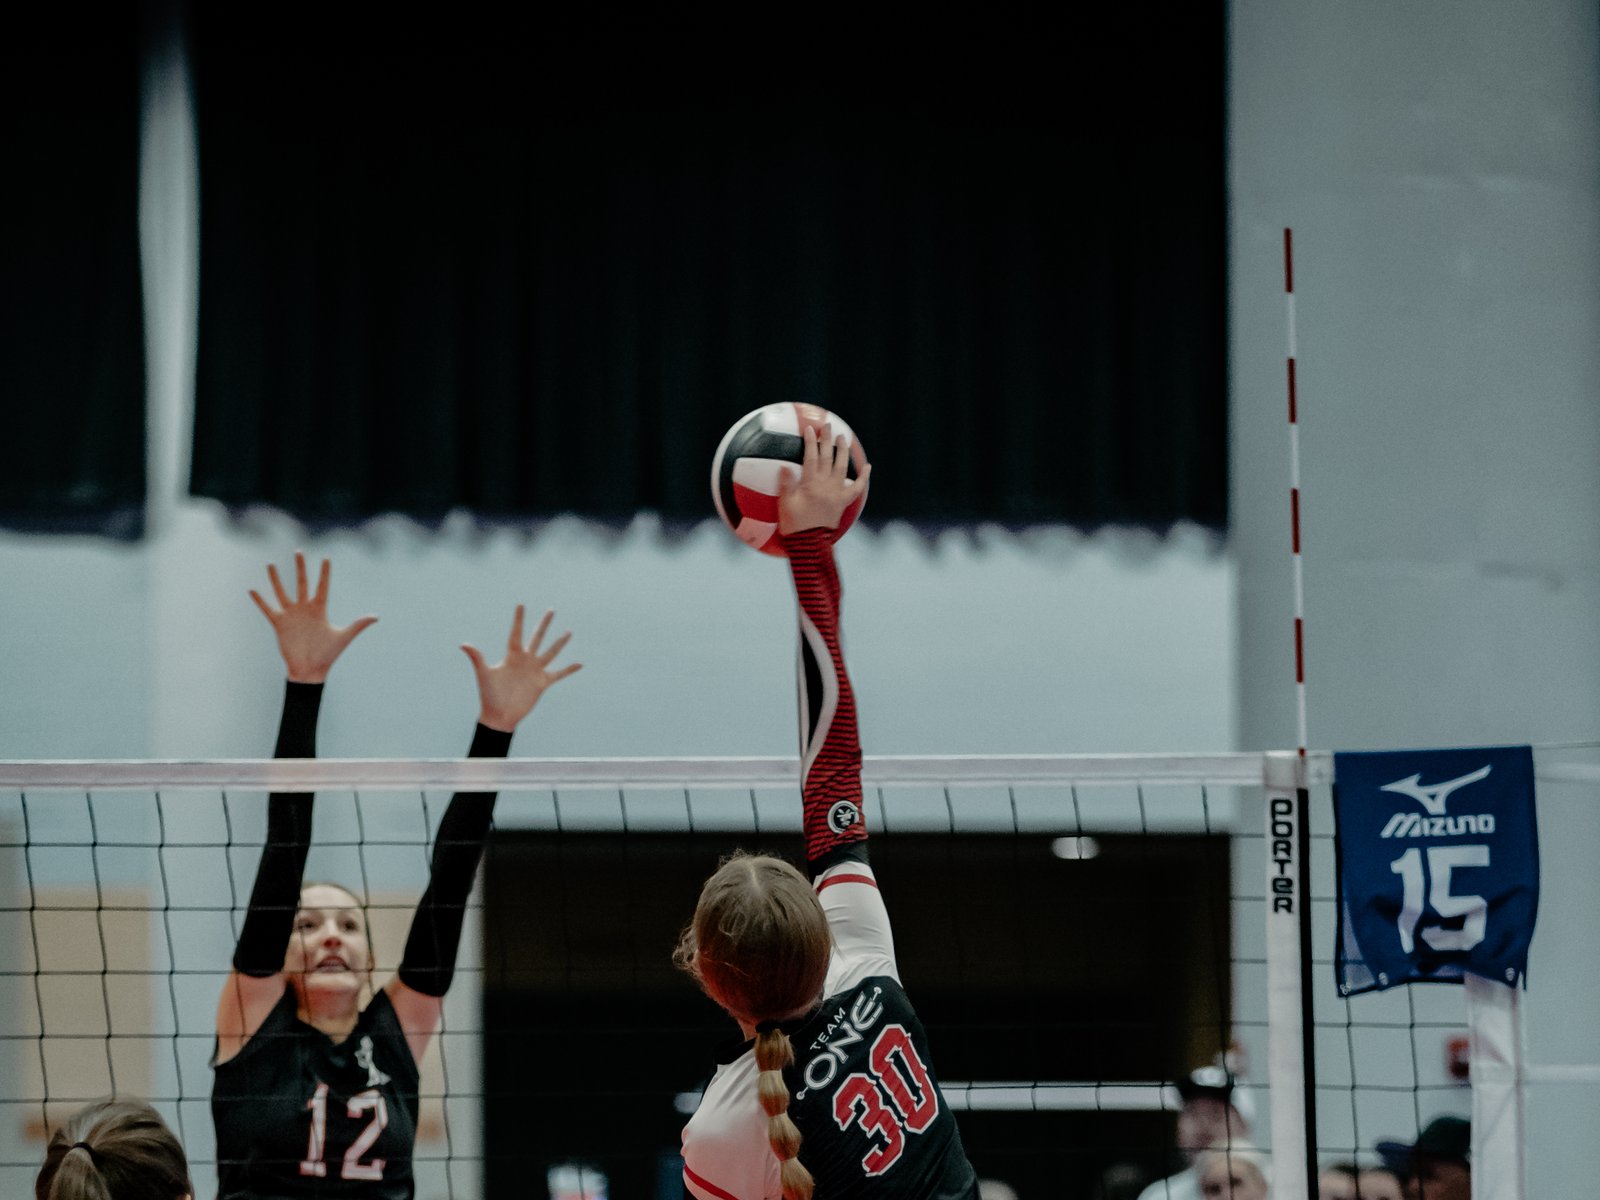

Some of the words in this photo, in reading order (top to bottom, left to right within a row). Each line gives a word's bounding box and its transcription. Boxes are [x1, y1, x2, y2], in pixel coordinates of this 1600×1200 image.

[1389, 844, 1490, 954] 15
[802, 990, 884, 1091] ONE
[810, 1006, 846, 1051] TEAM
[299, 1082, 389, 1181] 12
[832, 1023, 939, 1178] 30
